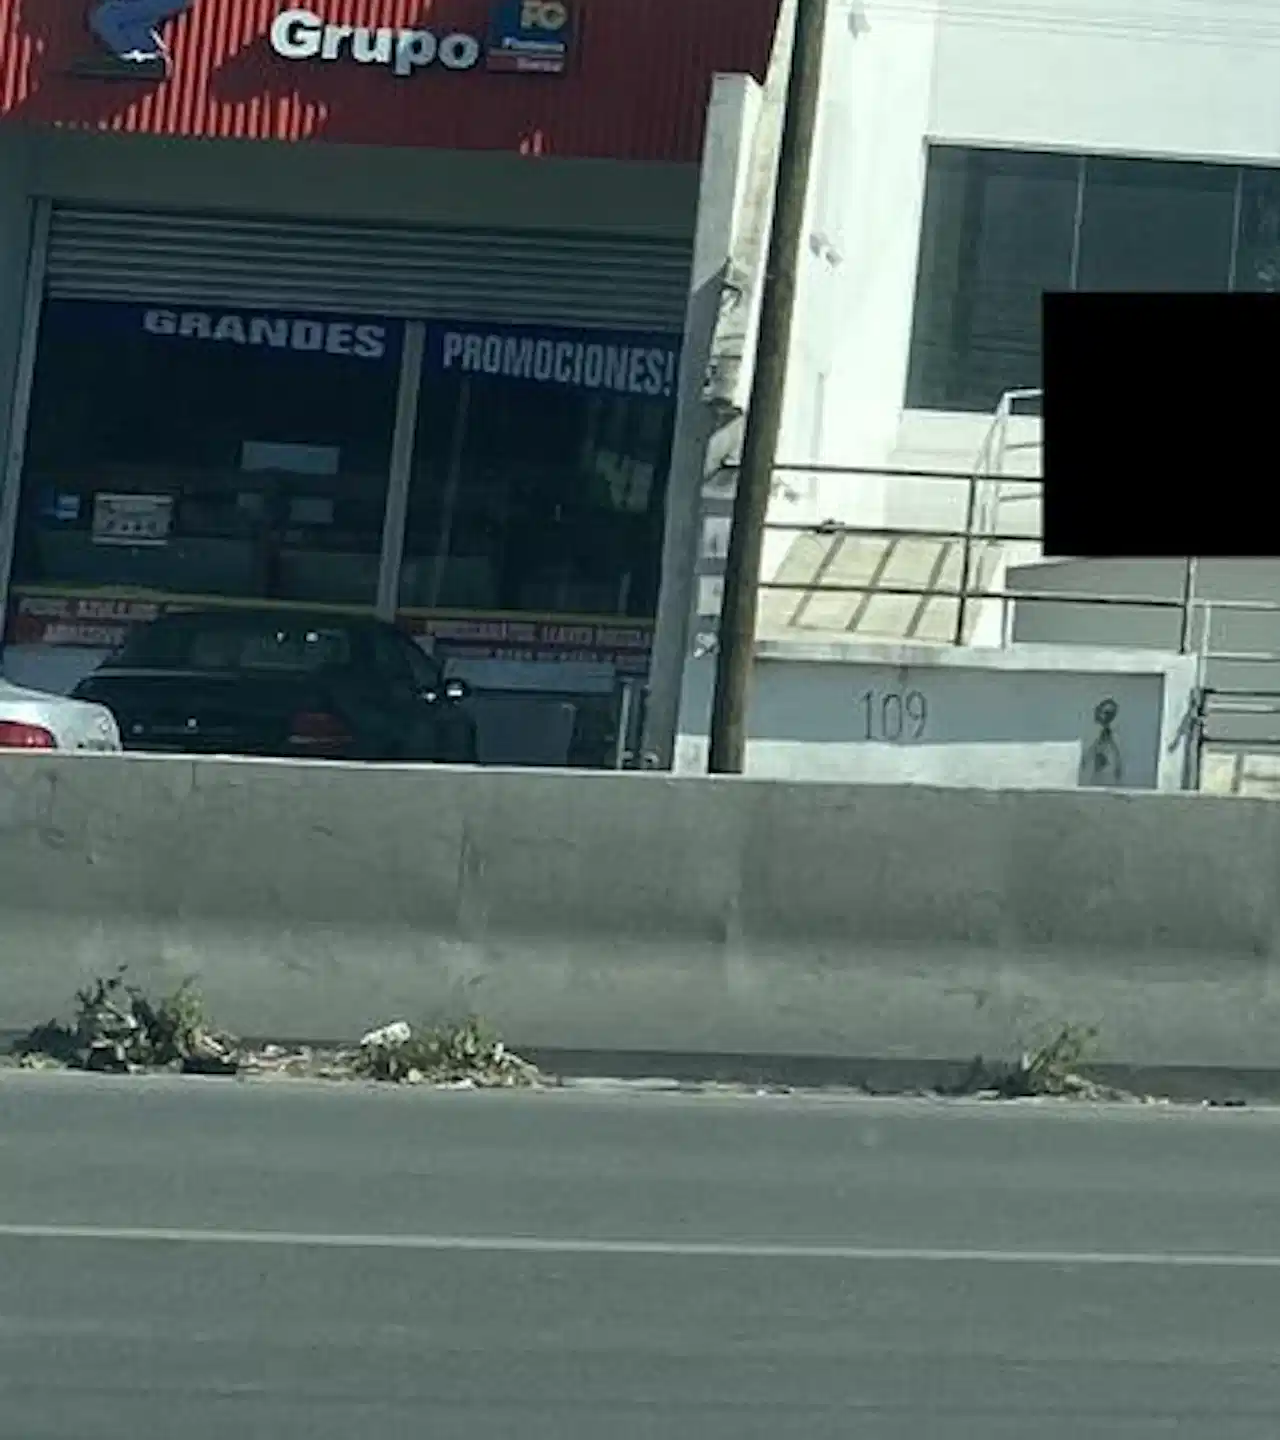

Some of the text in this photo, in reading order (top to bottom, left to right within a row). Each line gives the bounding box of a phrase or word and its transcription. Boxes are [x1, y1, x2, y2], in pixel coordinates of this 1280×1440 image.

[270, 8, 480, 76] Grupo
[143, 309, 674, 397] GRANDES PROMOCIONES!
[861, 689, 929, 741] 109
